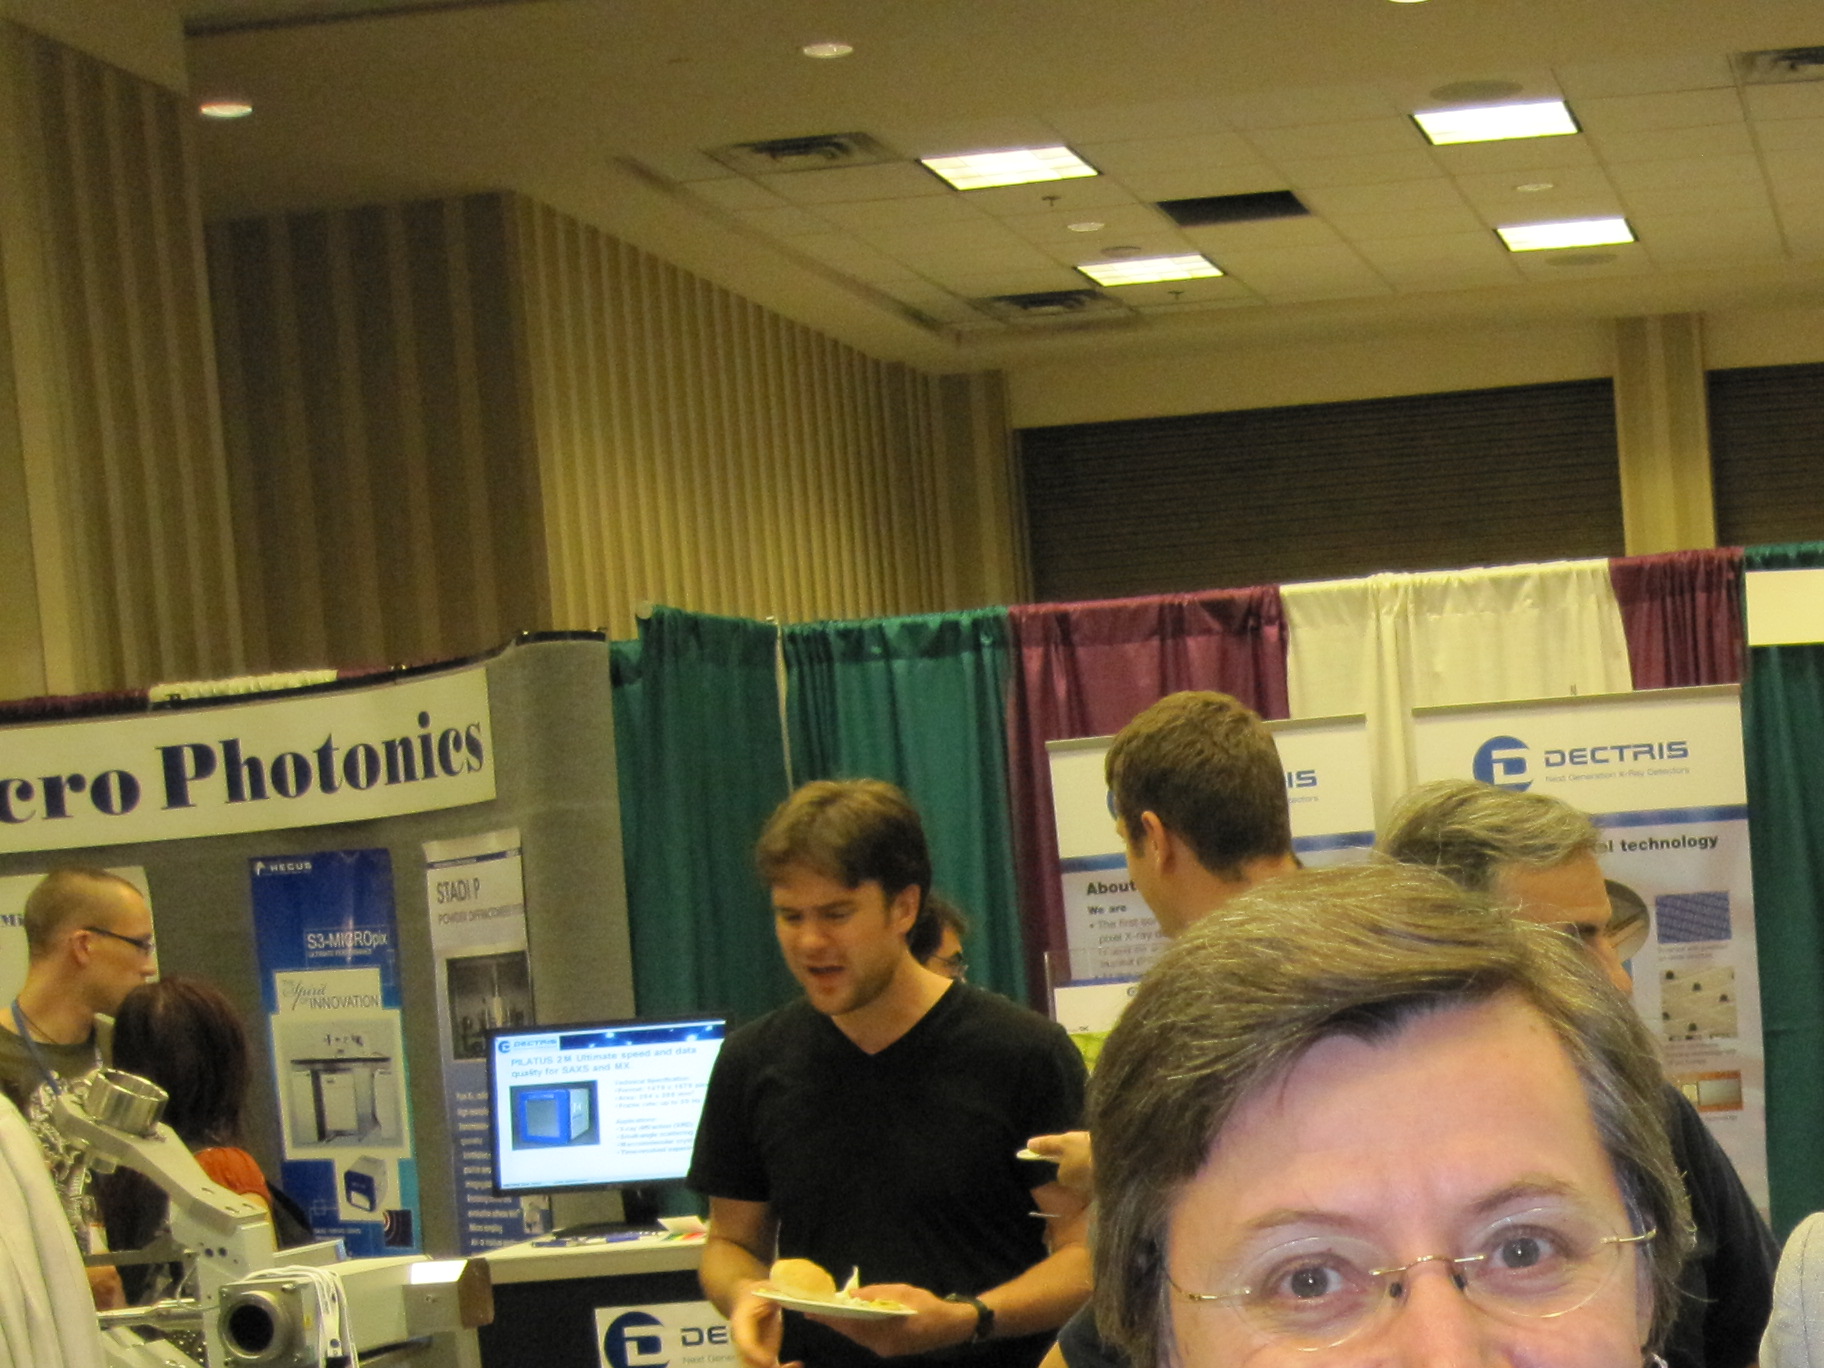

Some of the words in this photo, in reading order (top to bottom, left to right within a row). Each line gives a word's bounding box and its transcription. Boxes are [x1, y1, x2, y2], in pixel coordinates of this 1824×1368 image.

[156, 710, 486, 811] Photonics
[1544, 741, 1689, 767] DECTRIS
[1621, 834, 1719, 852] technology
[1087, 880, 1137, 895] About
[310, 995, 381, 1009] INNOVATION
[622, 1049, 650, 1060] speed
[654, 1047, 672, 1056] and
[675, 1046, 696, 1055] data
[511, 1067, 543, 1079] quality
[545, 1066, 559, 1076] for
[593, 1063, 610, 1072] and
[681, 1325, 728, 1346] DE
